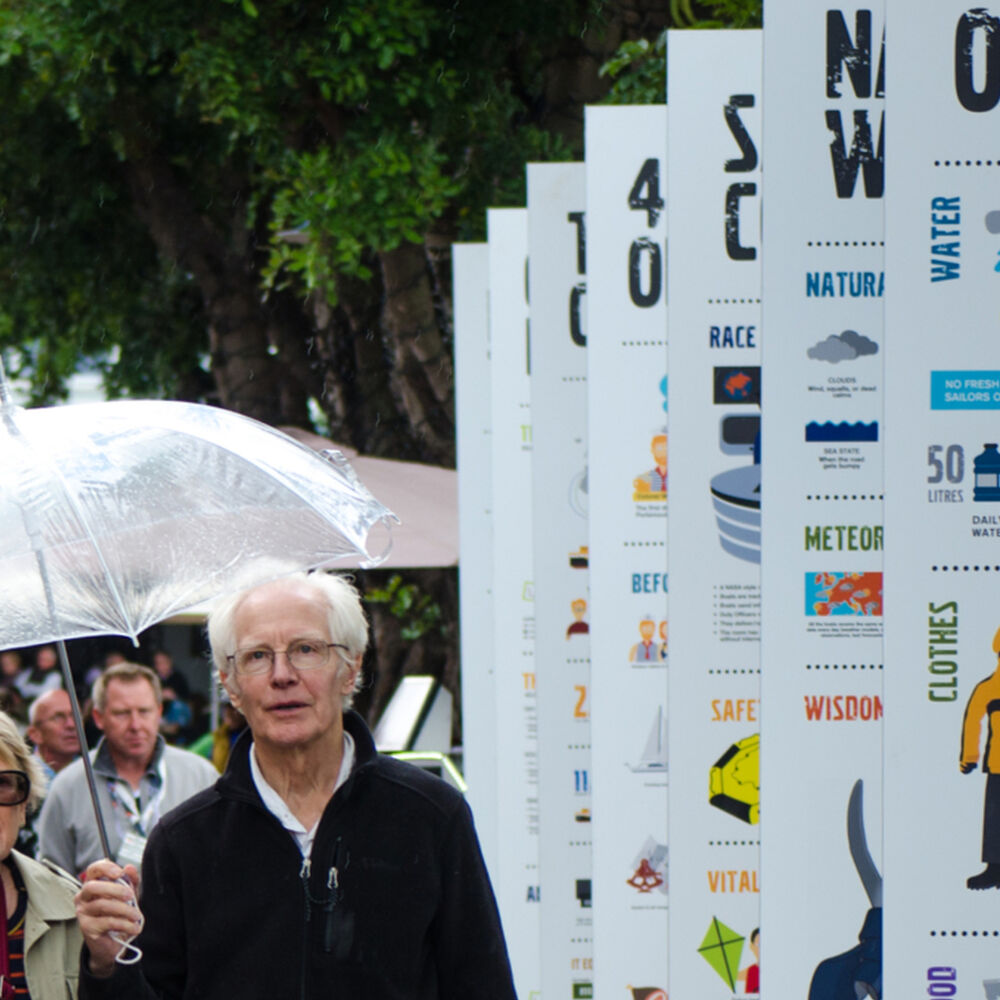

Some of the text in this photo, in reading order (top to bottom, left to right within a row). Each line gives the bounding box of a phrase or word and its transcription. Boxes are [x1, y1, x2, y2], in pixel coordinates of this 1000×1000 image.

[826, 9, 885, 99] N
[930, 197, 961, 282] WATER
[709, 326, 757, 348] RACE
[945, 380, 999, 389] NO FRESH
[945, 392, 990, 402] SAILORS
[927, 444, 965, 484] 50
[928, 489, 964, 503] LITRES
[928, 601, 958, 702] CLOTHES
[711, 699, 761, 722] SAFE
[706, 870, 760, 893] VITAL
